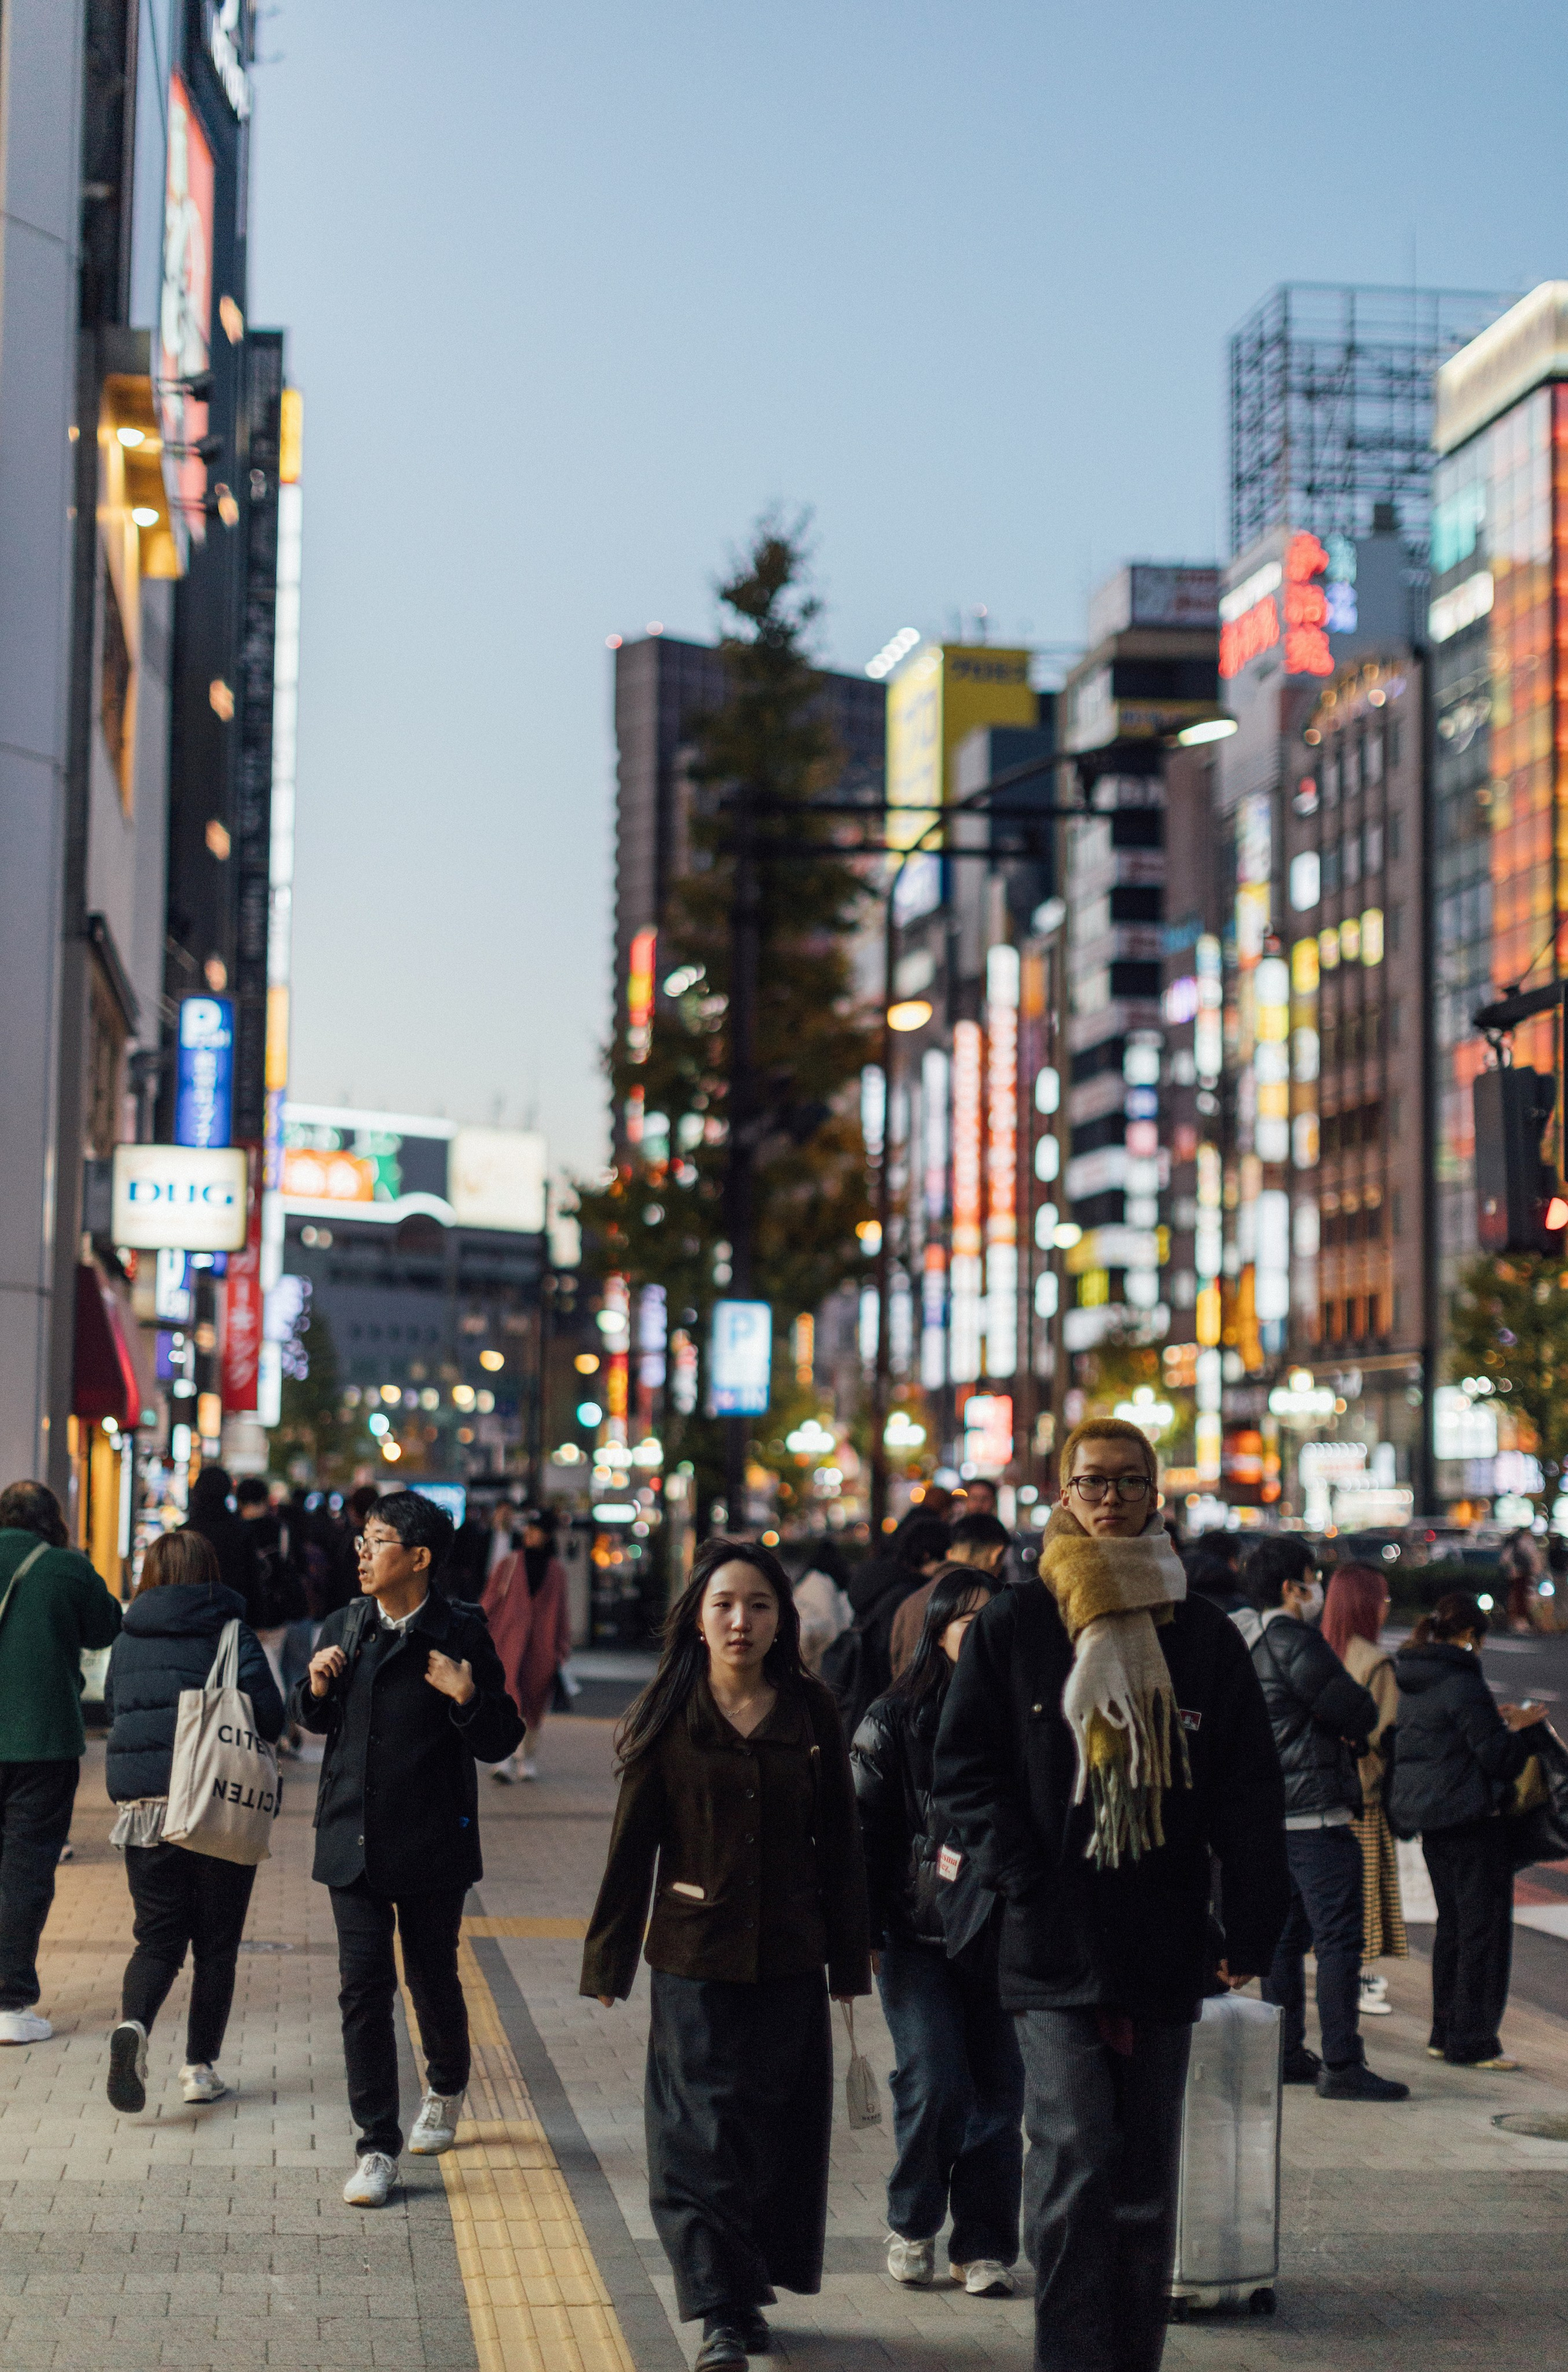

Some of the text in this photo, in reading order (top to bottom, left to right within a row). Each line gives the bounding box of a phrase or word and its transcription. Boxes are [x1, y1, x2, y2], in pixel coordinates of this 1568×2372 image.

[181, 998, 222, 1049] P
[129, 1181, 234, 1205] DUG
[731, 1312, 758, 1350] P
[217, 1724, 268, 1754] CITE
[213, 1778, 274, 1813] CITEN
